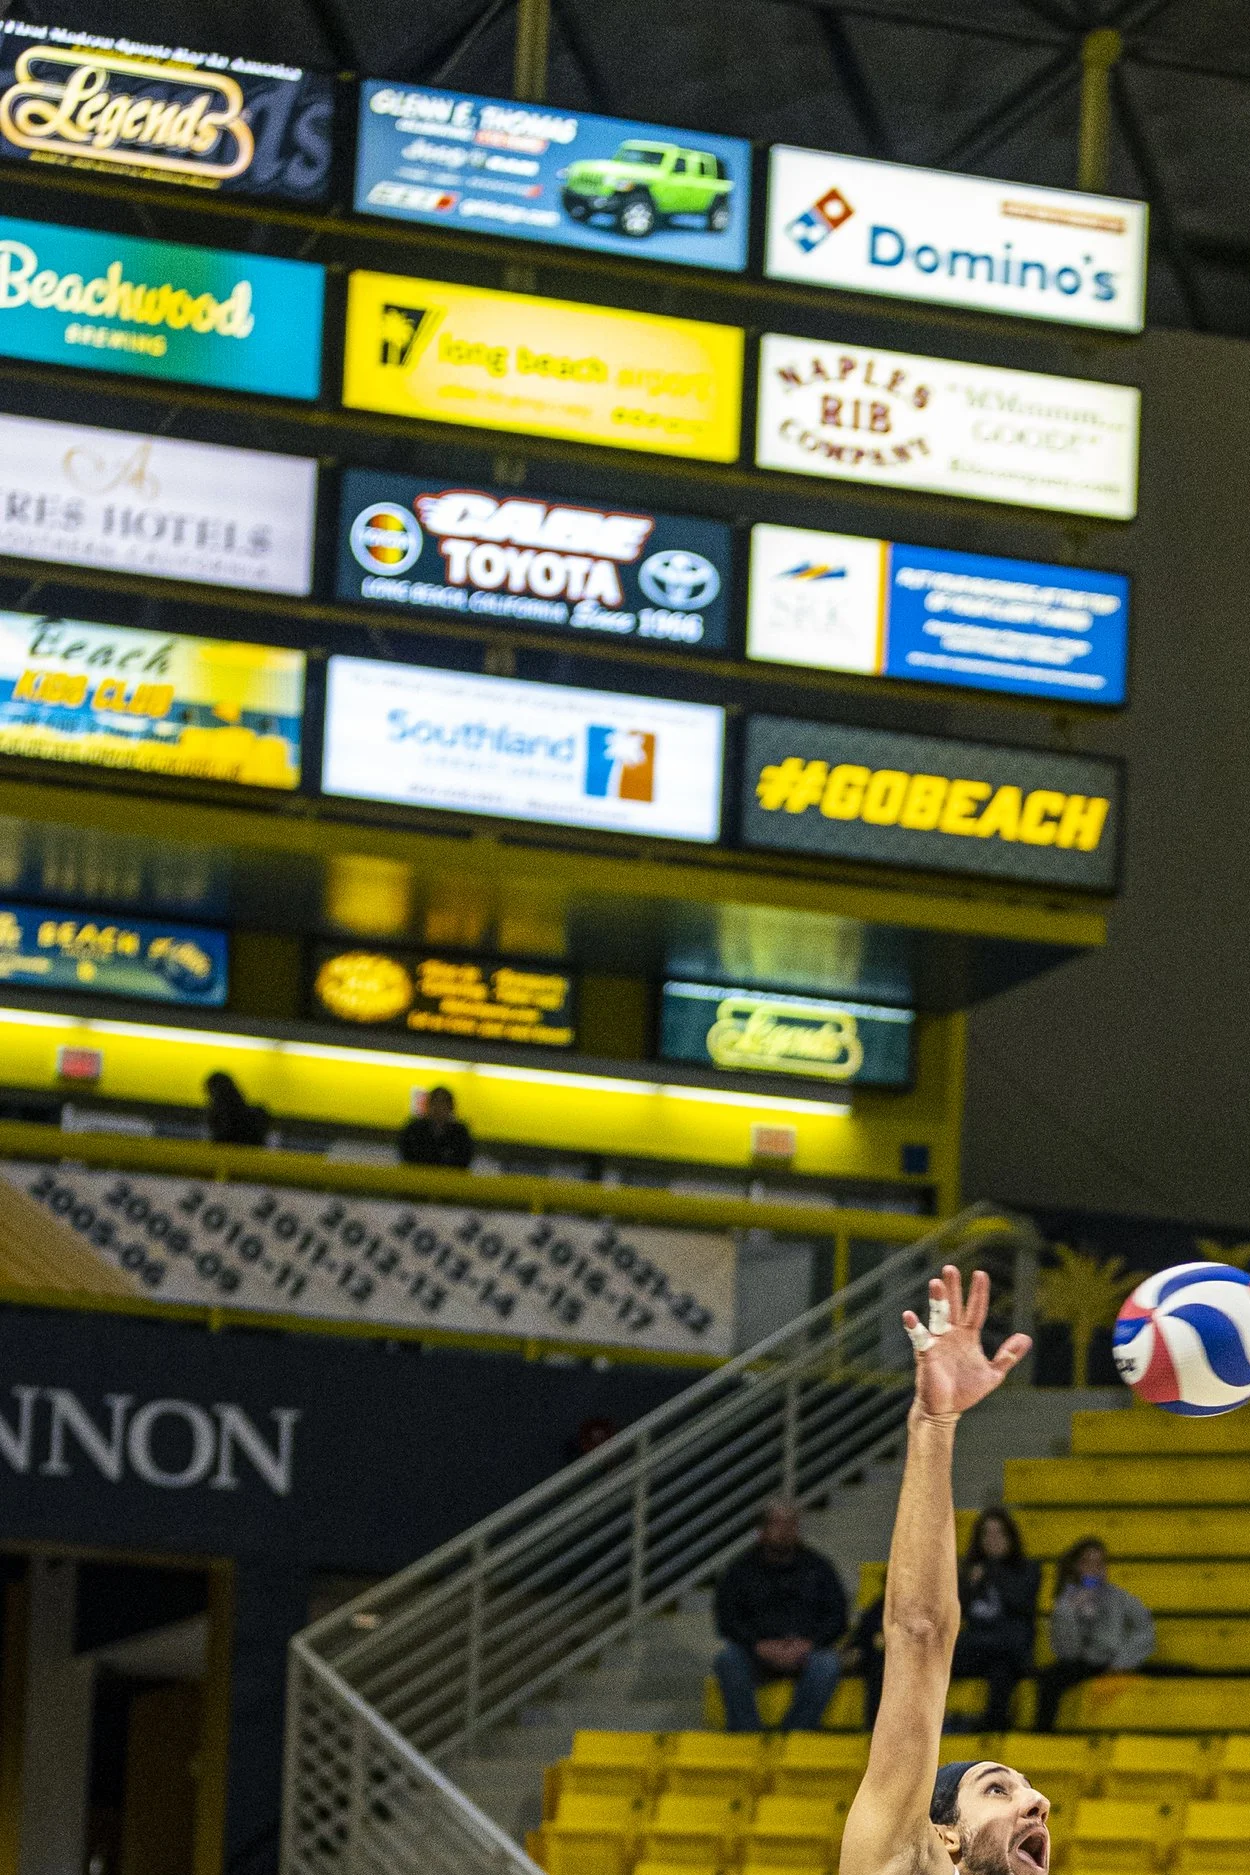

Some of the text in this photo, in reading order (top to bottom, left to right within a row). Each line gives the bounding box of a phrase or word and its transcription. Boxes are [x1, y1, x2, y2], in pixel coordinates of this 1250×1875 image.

[14, 64, 220, 154] Legends
[369, 89, 454, 123] GLENN
[479, 105, 579, 144] THOMAS
[0, 241, 254, 339] Beachwood
[867, 224, 1118, 302] Domino's
[65, 322, 168, 357] BREWING
[438, 332, 509, 378] long
[516, 345, 608, 383] beach
[777, 356, 931, 410] NAPLES
[778, 418, 931, 467] COMPANY
[820, 394, 893, 433] RIB
[103, 503, 272, 556] HOTELS
[415, 489, 655, 563] CABE
[439, 537, 624, 608] TOYOTA
[361, 576, 409, 603] LONG
[469, 590, 570, 625] CALIFORNIA
[570, 599, 636, 633] Since
[28, 614, 180, 676] Beach
[386, 706, 577, 764] Southland
[754, 756, 1111, 853] #GOBEACH
[180, 1187, 307, 1300] 2010-11
[253, 1194, 375, 1303] 2011-12
